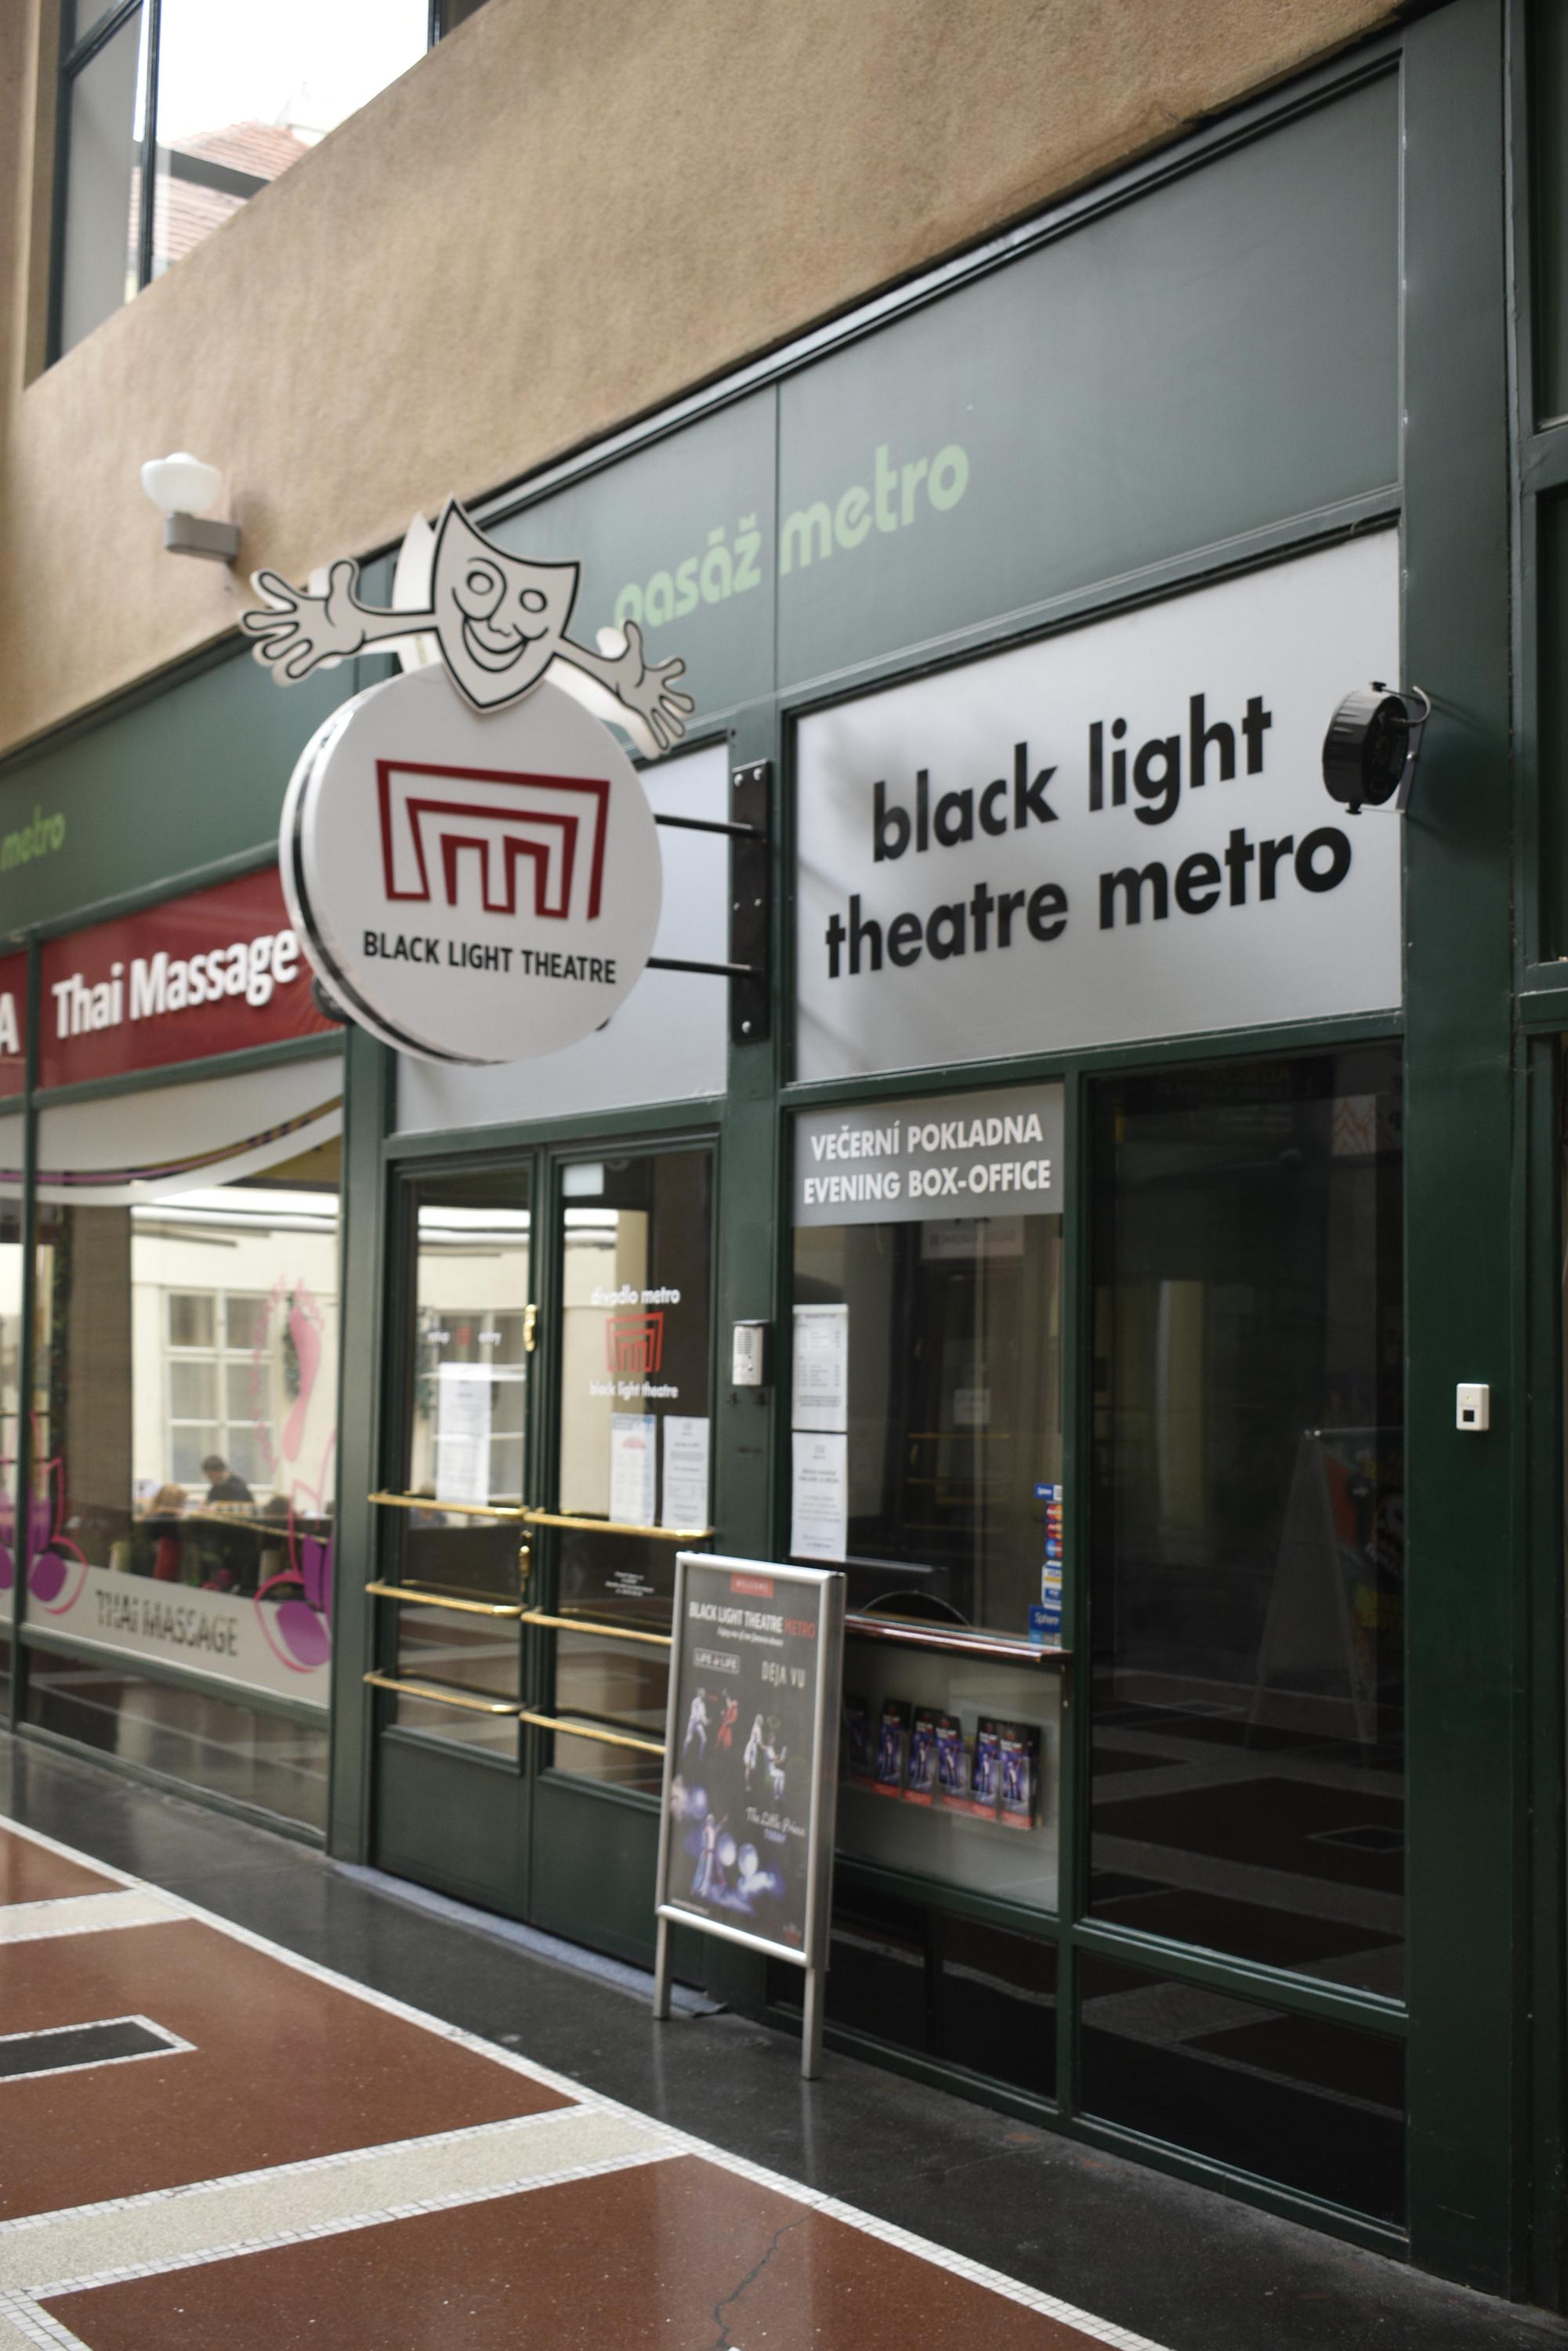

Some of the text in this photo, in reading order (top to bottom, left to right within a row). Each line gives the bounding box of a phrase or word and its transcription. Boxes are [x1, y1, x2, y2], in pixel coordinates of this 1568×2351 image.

[779, 443, 970, 578] metro
[873, 693, 1273, 863] black light
[825, 827, 1352, 980] theatre metro
[52, 929, 299, 1039] Thai Massage
[363, 930, 617, 984] BLACK LIGHT THEATRE
[811, 1114, 1043, 1161] VEČERNÍ POKLADNA
[803, 1160, 1051, 1204] EVENING BOX-OFFICE
[640, 1286, 681, 1304] metro
[617, 1380, 640, 1401] light
[642, 1380, 679, 1398] theatre
[95, 1588, 239, 1657] THAI MASSAGE
[688, 1600, 717, 1621] BLACK
[717, 1607, 743, 1626] LIGHT
[744, 1610, 784, 1634] THEATRE
